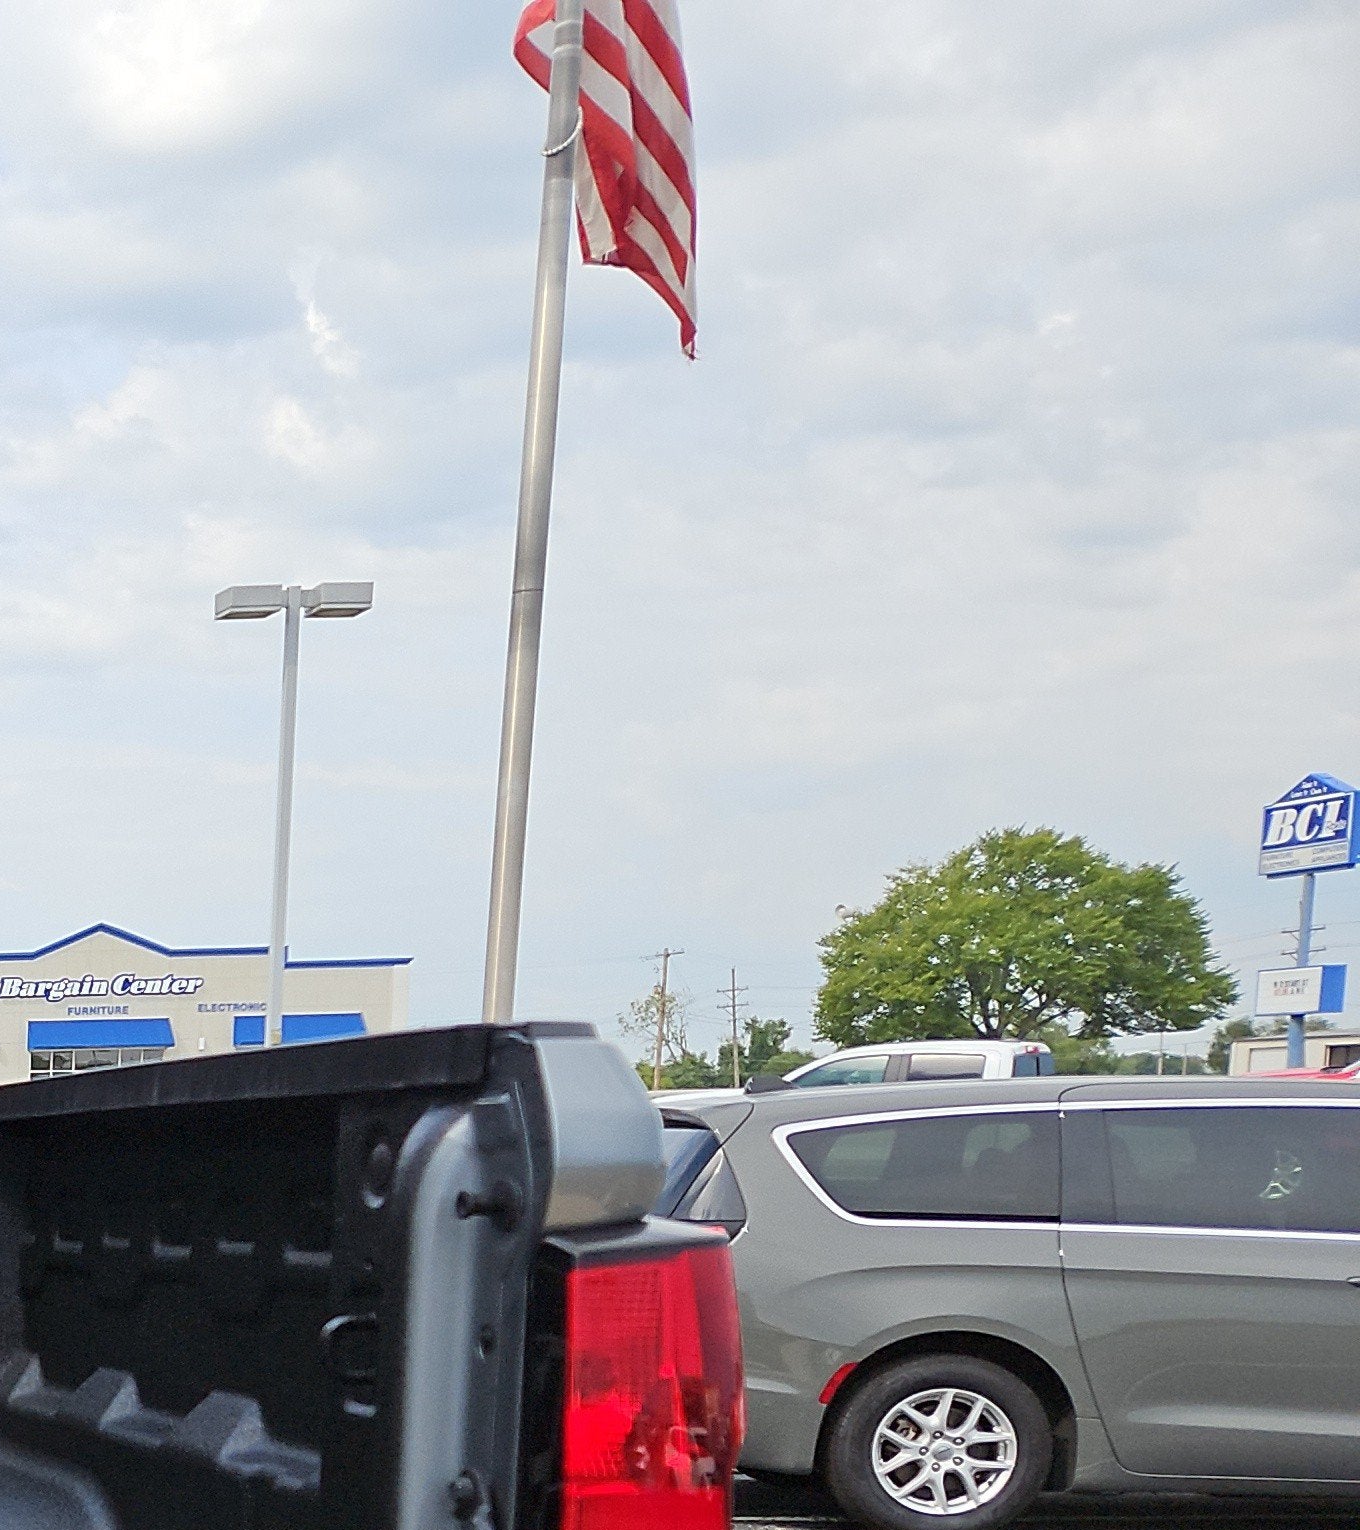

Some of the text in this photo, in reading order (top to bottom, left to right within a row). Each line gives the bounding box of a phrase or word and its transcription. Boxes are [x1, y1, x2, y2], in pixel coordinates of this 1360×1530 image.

[110, 973, 204, 996] Center
[67, 1006, 129, 1016] FURNITURE
[197, 1003, 267, 1013] ELECTRONIC
